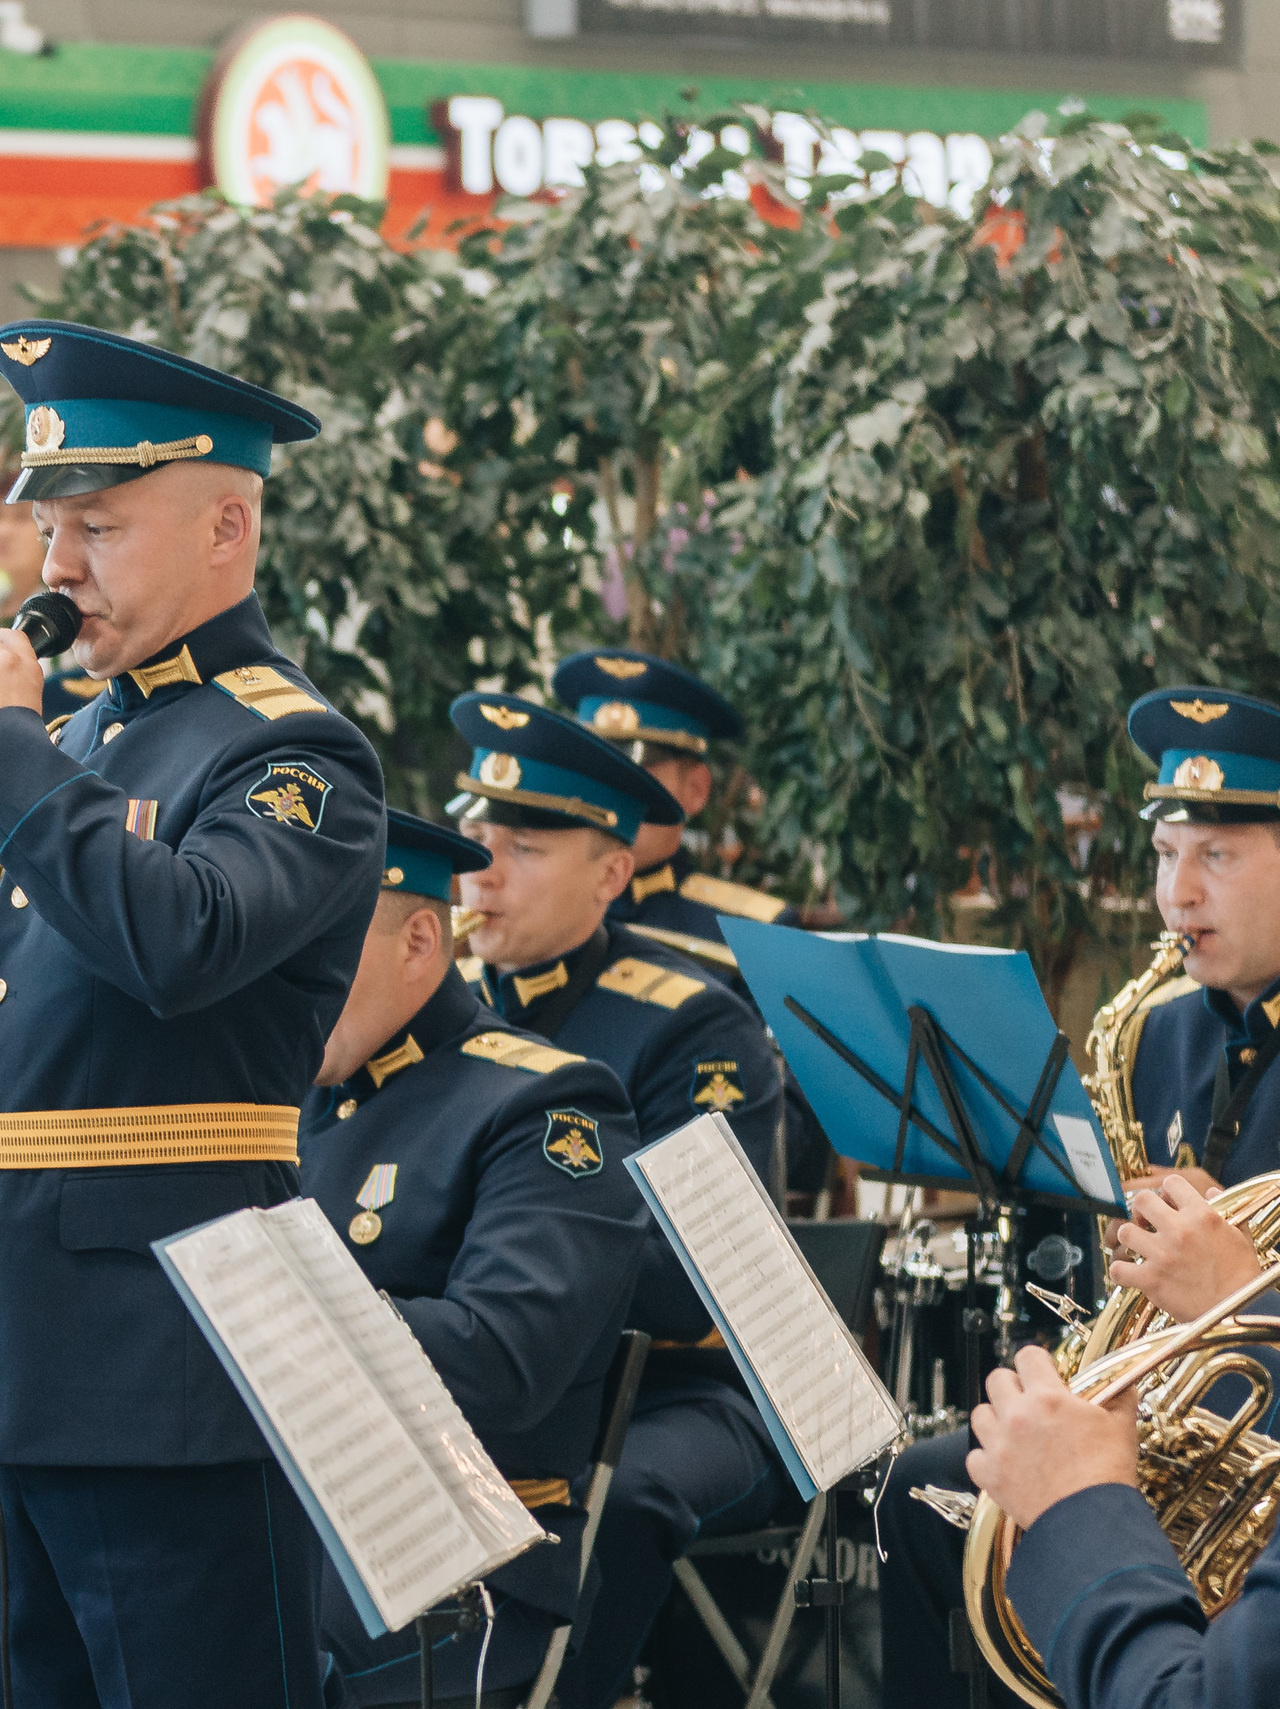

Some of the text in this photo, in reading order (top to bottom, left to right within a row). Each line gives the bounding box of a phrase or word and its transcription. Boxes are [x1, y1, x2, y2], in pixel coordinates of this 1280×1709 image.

[273, 767, 326, 792] РОССИЯ
[697, 1061, 737, 1073] РОССИЯ
[552, 1113, 594, 1130] РОССИЯ
